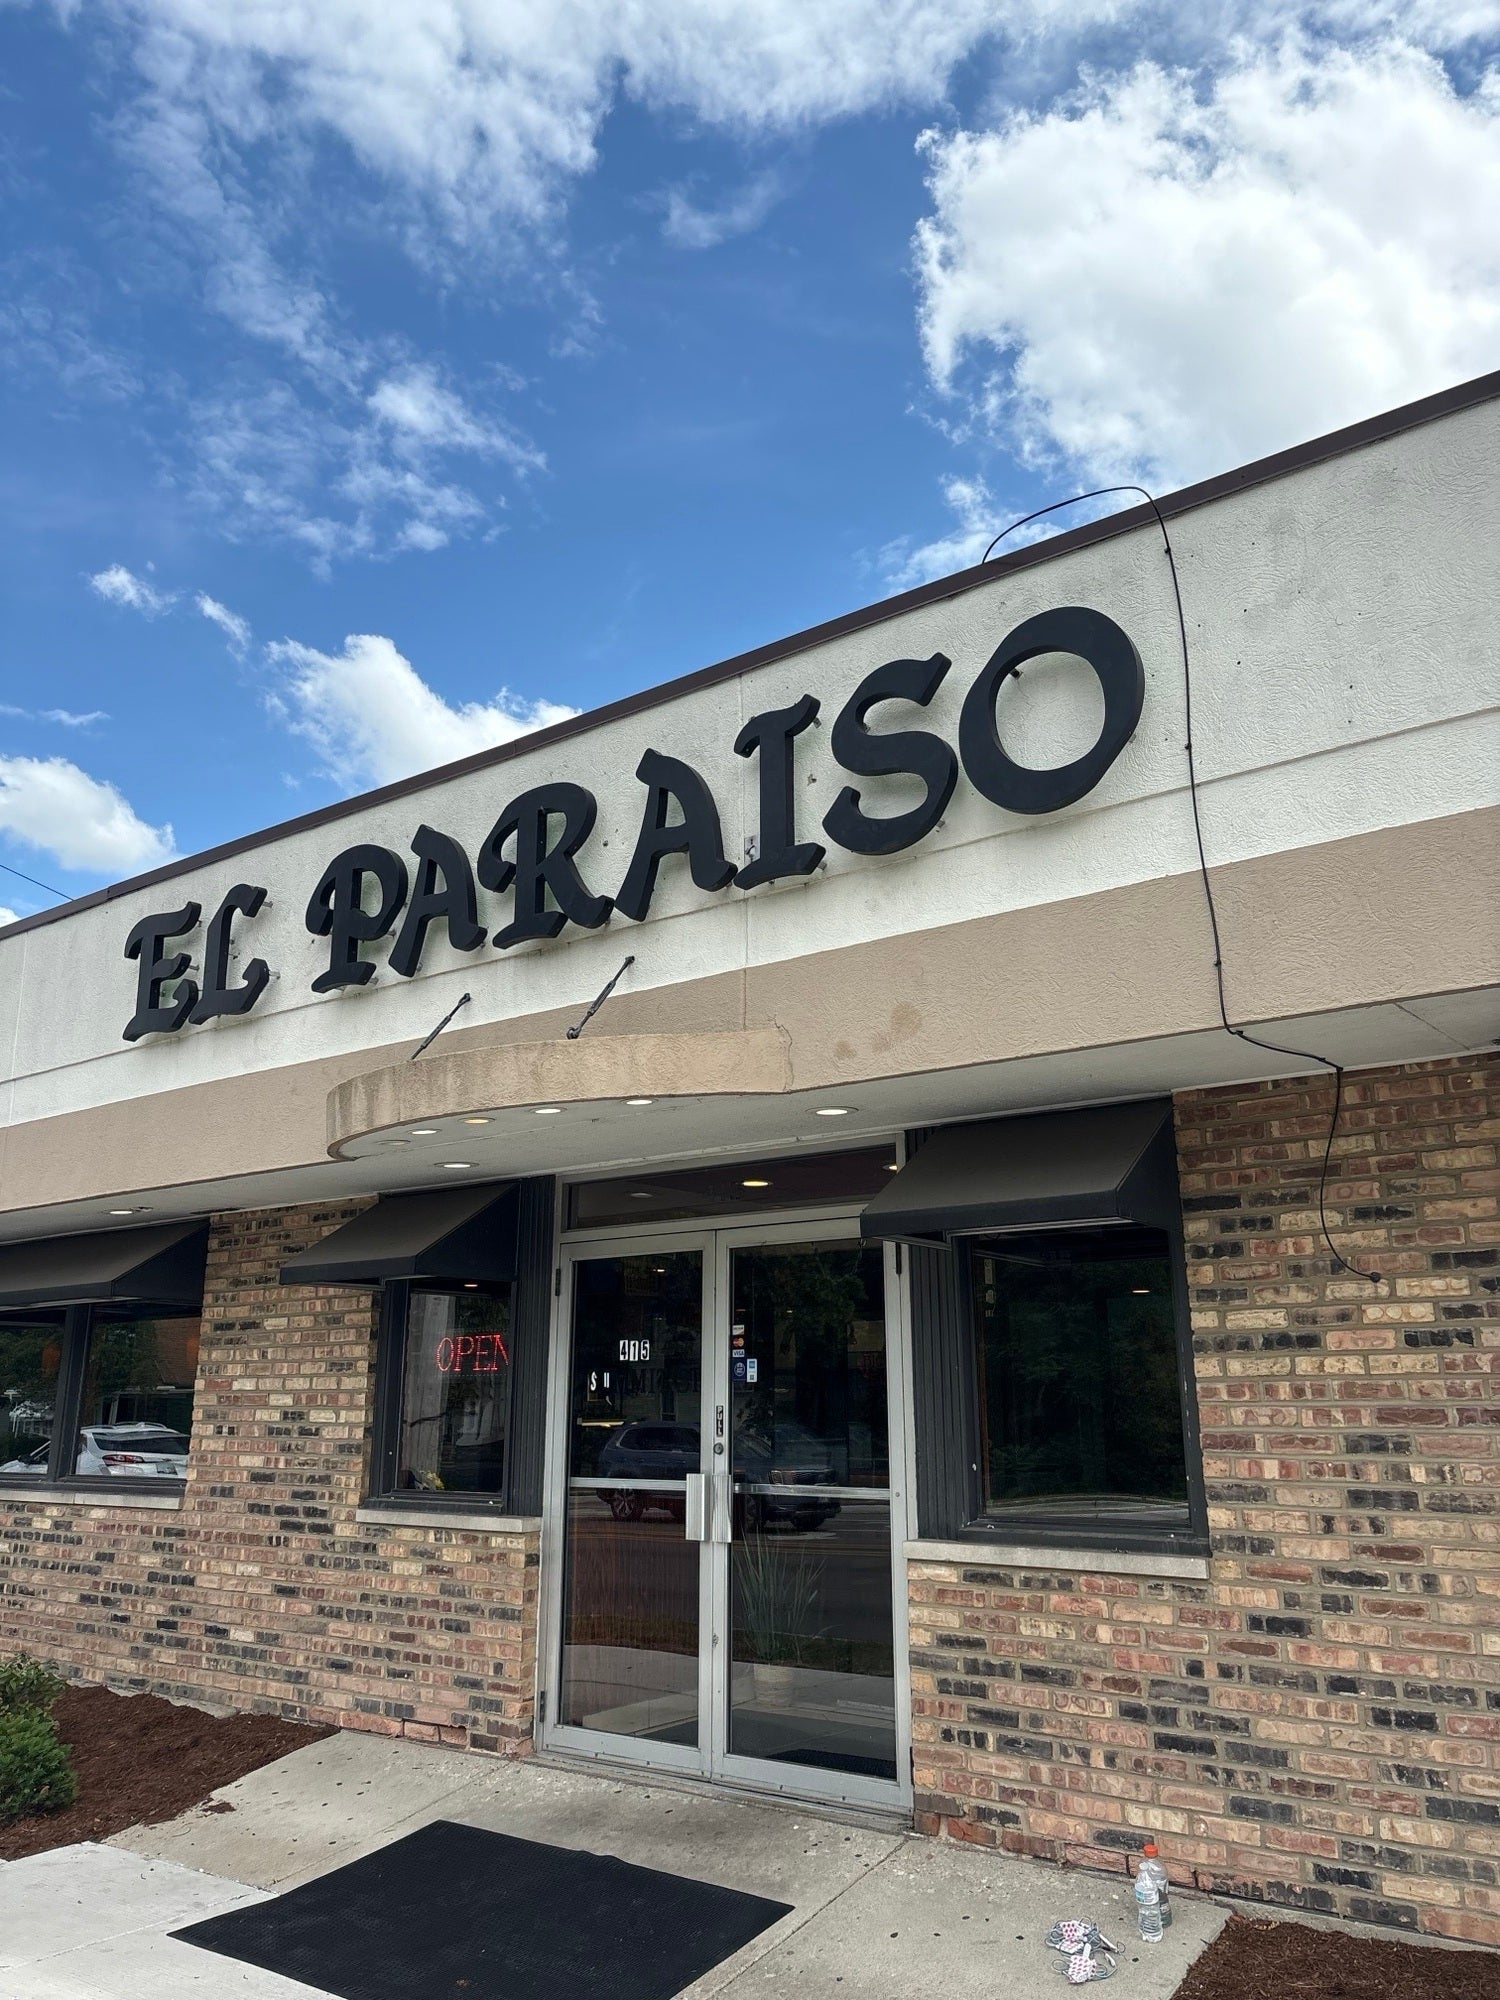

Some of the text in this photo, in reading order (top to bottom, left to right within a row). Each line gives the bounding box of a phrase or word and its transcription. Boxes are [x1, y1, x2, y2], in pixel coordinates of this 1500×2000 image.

[123, 605, 1145, 1041] EL PARAISO
[437, 1334, 509, 1371] OPEN
[620, 1340, 650, 1360] 415
